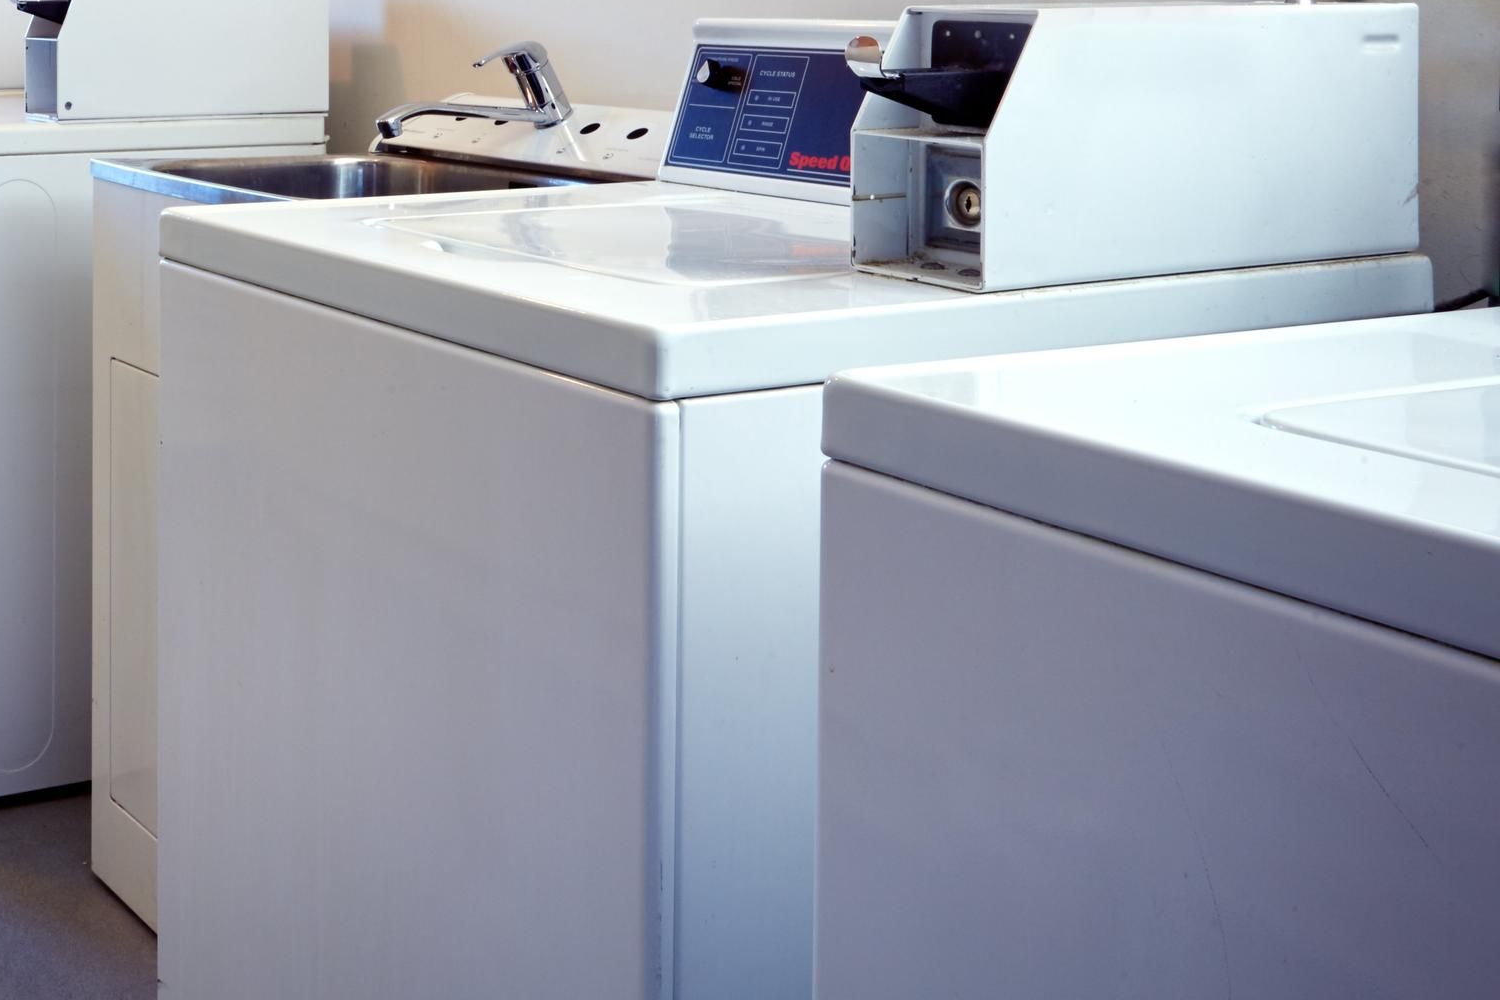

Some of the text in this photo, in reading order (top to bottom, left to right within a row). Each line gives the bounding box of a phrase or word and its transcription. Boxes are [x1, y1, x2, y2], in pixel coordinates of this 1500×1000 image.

[776, 70, 796, 78] STATUS
[688, 132, 714, 140] SELECTOR
[789, 151, 839, 170] Speed
